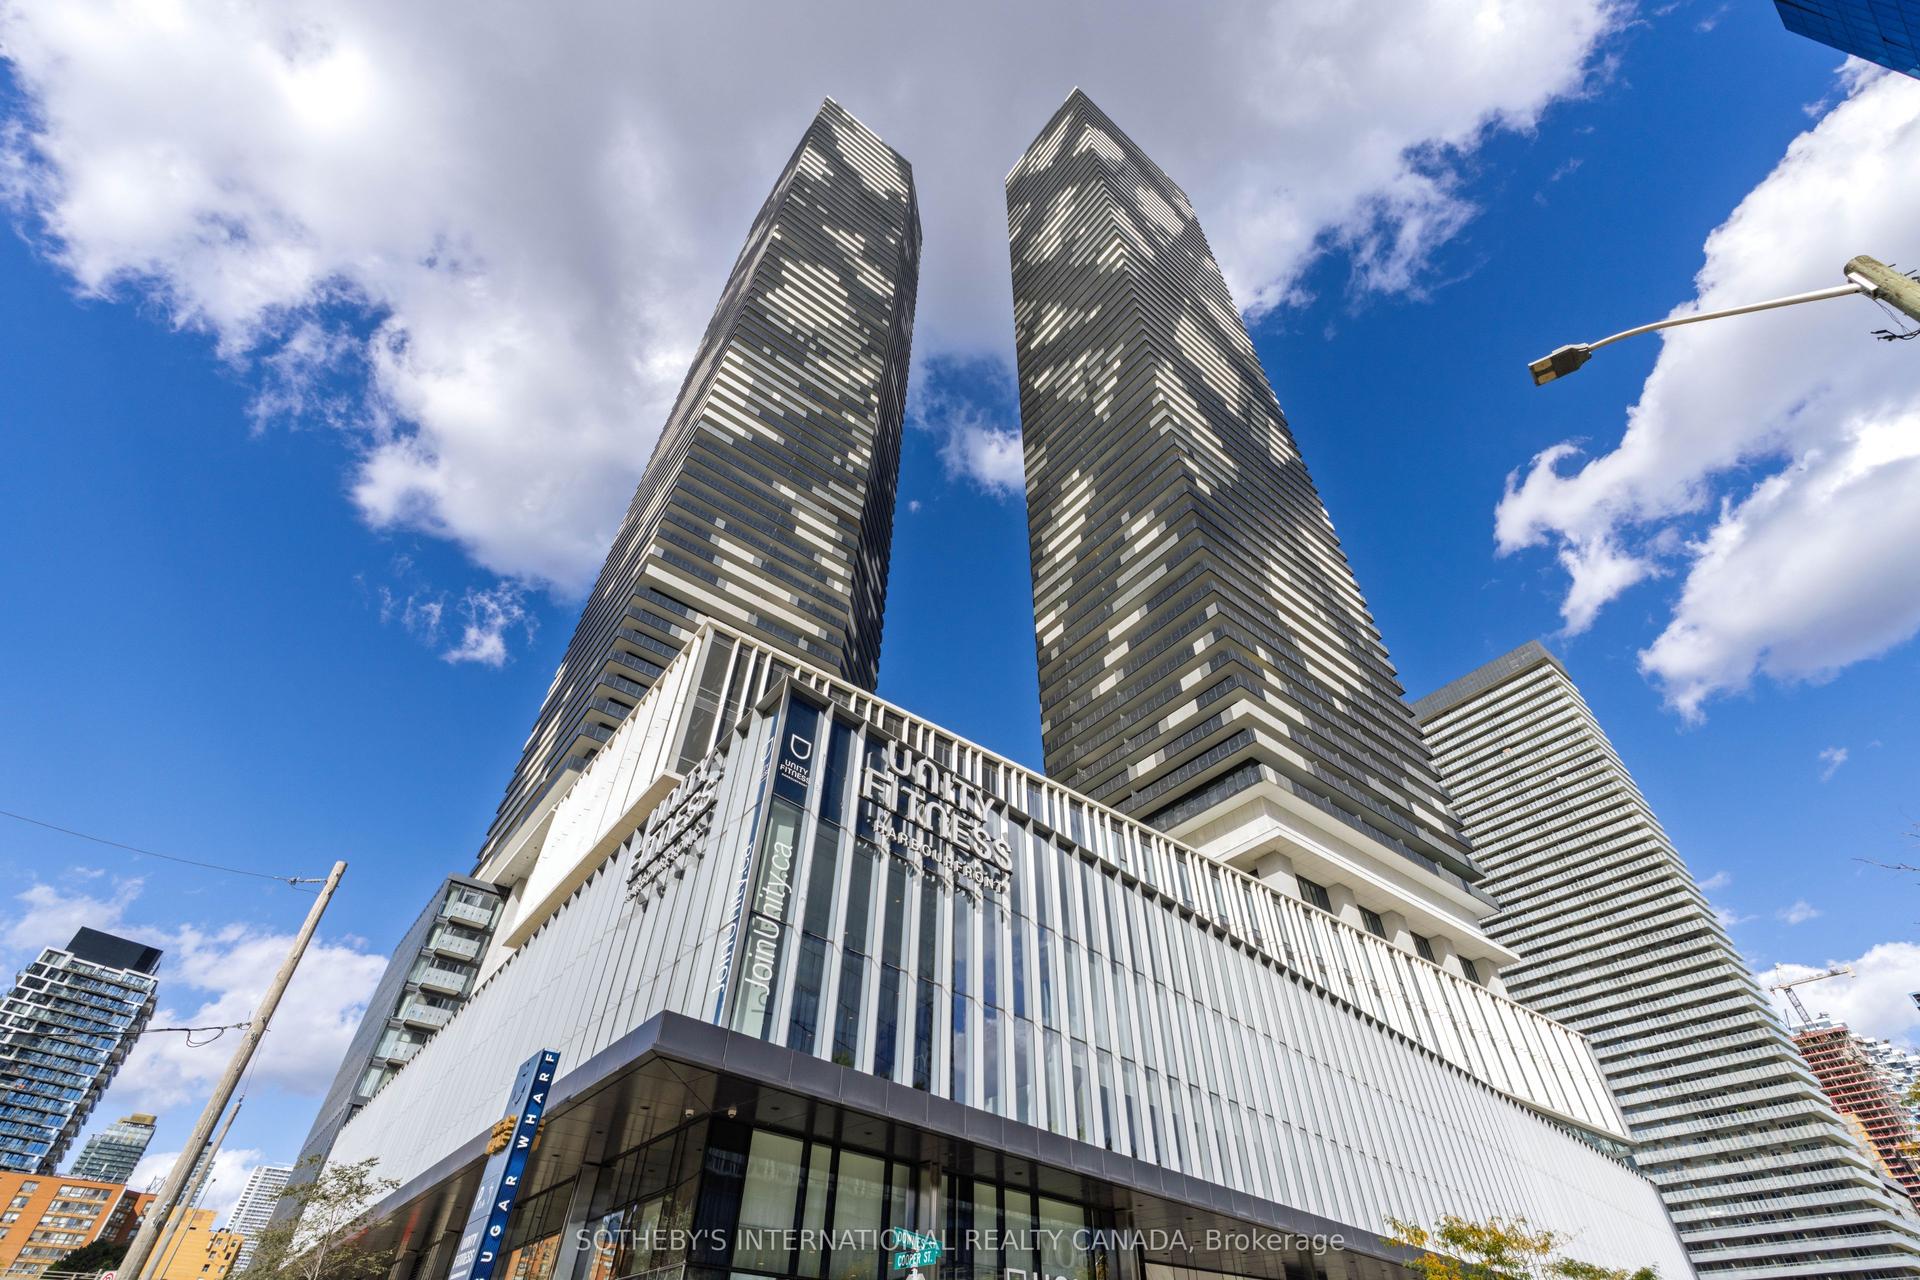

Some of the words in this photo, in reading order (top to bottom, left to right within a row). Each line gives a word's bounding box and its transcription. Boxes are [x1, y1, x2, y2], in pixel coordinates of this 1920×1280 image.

[873, 820, 1003, 893] HARBOURFRONT
[745, 840, 793, 996] JoinUnity.ca
[476, 1175, 518, 1280] UGAR
[516, 1053, 555, 1149] WHARF
[897, 1252, 921, 1267] COOPER
